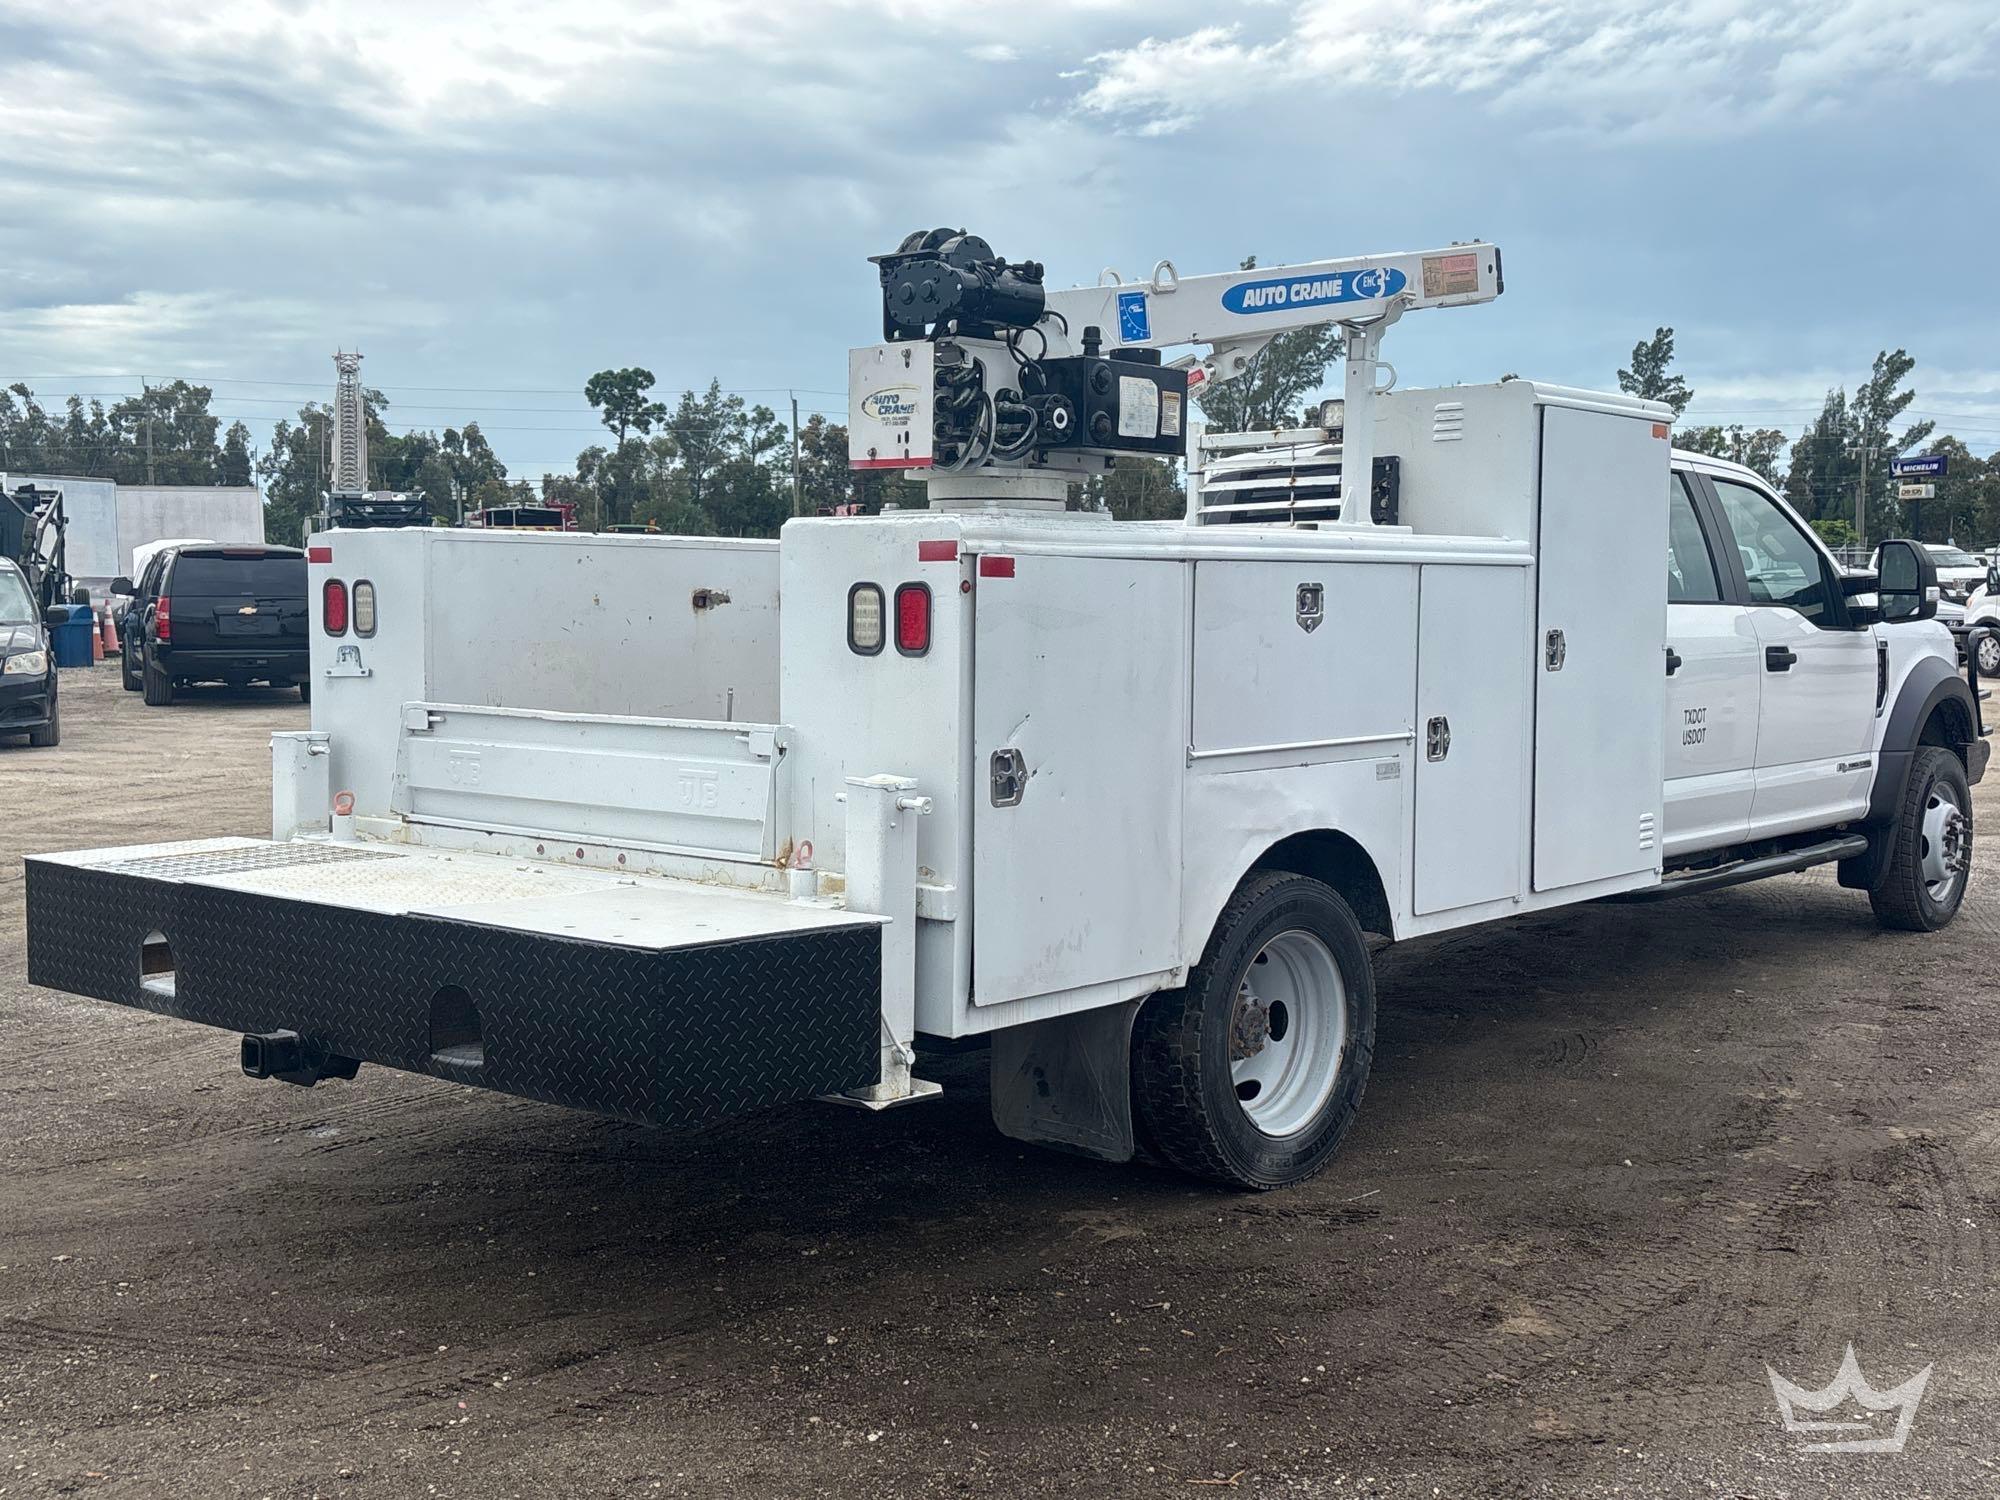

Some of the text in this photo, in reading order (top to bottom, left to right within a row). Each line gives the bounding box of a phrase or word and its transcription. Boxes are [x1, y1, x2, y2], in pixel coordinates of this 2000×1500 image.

[1363, 274, 1377, 288] EHC
[1242, 279, 1343, 308] AUTO CRANE
[872, 394, 900, 405] AUTO
[1903, 463, 1939, 472] MICHELIN
[1682, 727, 1706, 746] USDOT
